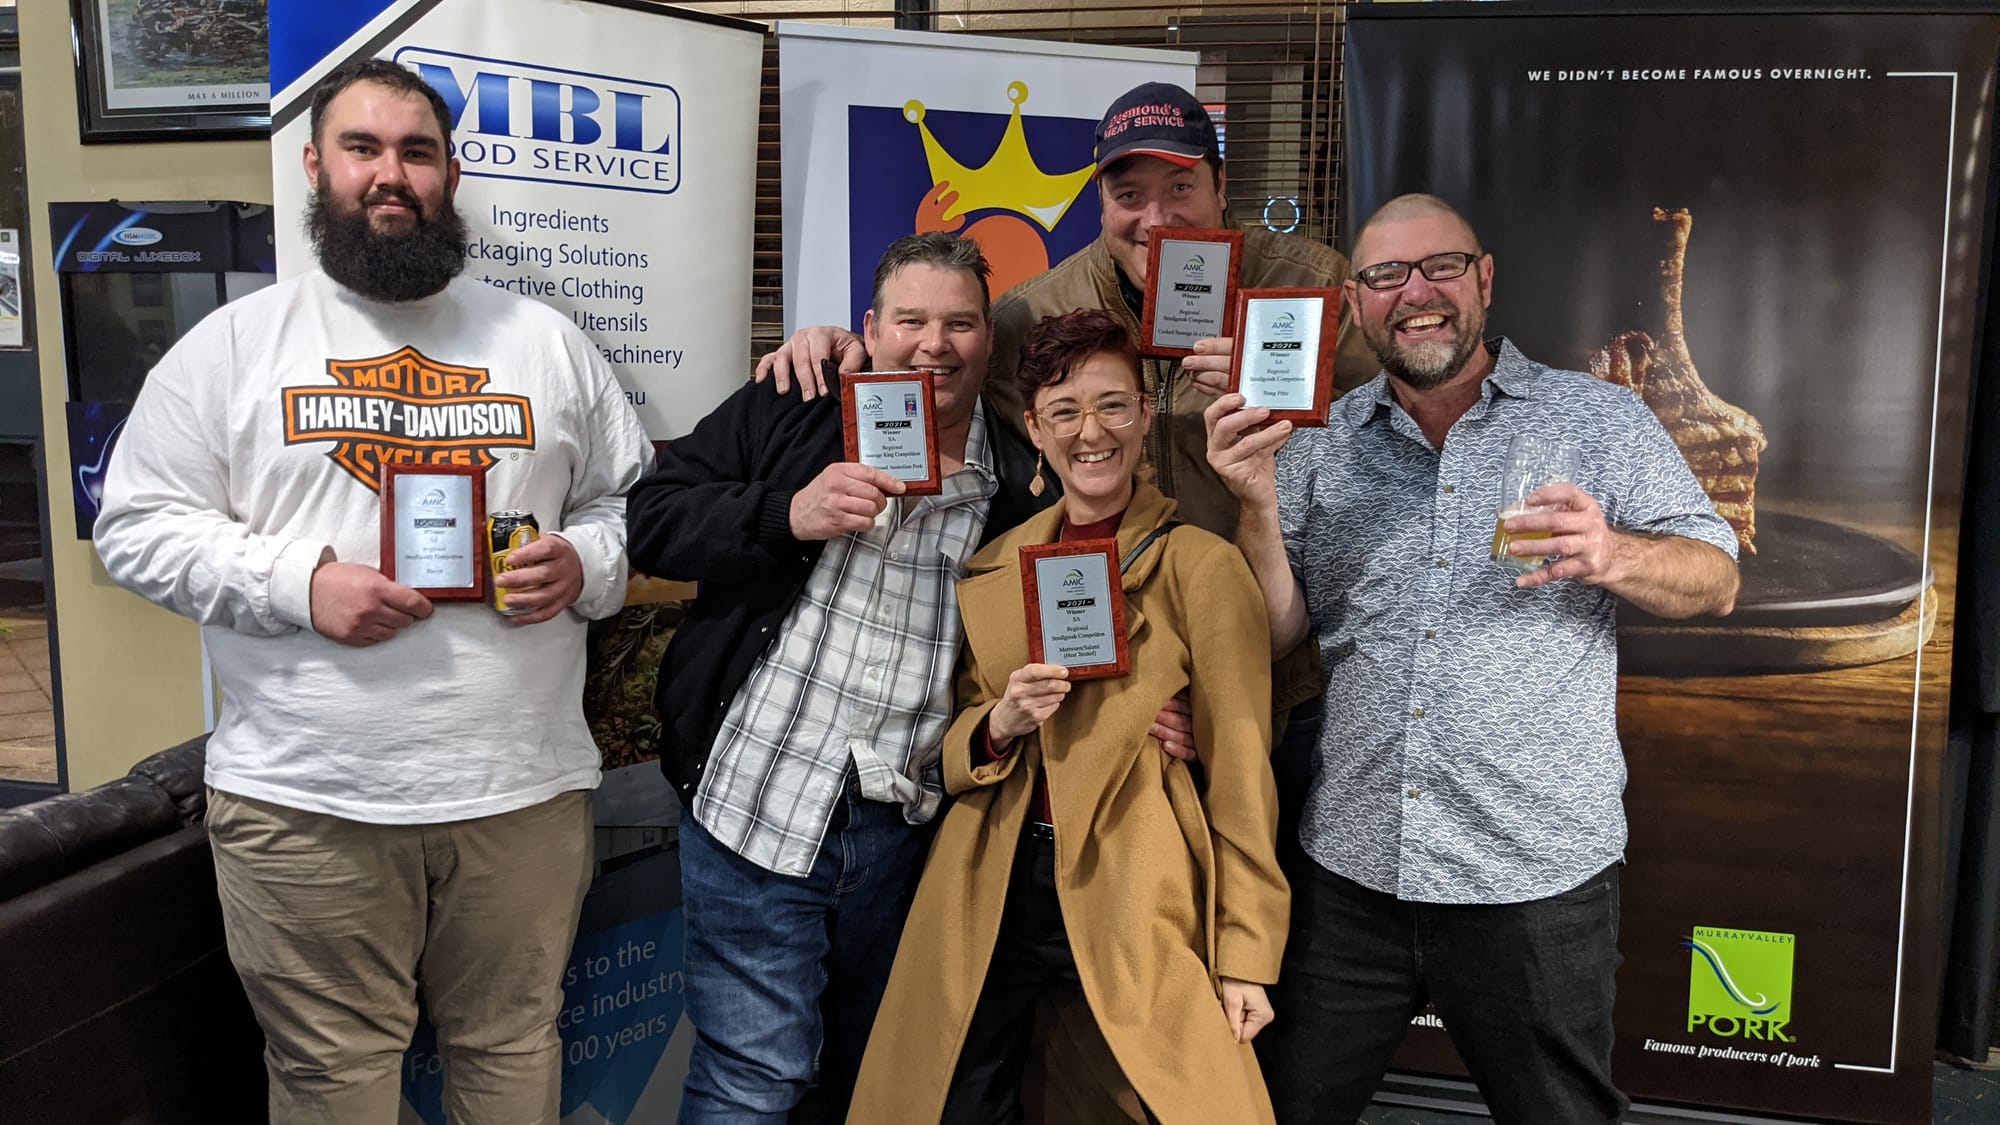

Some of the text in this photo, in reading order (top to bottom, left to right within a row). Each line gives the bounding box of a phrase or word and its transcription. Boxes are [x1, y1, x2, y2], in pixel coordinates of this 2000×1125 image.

[1528, 69, 1872, 81] WE DIDN'T BECOME FAMOUS OVERNIGHT.
[188, 90, 260, 100] MAX A MILLION
[407, 61, 670, 155] MBL
[1103, 115, 1185, 140] MEAT SERVICE
[450, 140, 670, 182] OD SERVICE
[493, 204, 609, 233] Ingredients
[76, 251, 201, 262] DIGITAL JUKEBOX
[559, 243, 649, 269] Solutions
[1183, 263, 1204, 271] AMIC
[561, 277, 644, 305] Clothing
[574, 310, 648, 333] Utensils
[596, 344, 684, 369] achinery
[353, 358, 468, 396] MOTOR
[299, 396, 522, 438] HARLEY-DAVIDSON
[863, 403, 883, 411] AMIC
[1063, 577, 1084, 587] AMIC
[1066, 599, 1086, 607] 2021
[1066, 625, 1088, 633] Regional
[1078, 631, 1105, 640] Competition
[1696, 929, 1793, 944] MURRAYVALLEY
[584, 957, 610, 980] to
[617, 940, 656, 969] the
[592, 970, 684, 1017] industry
[605, 1013, 667, 1059] years
[1687, 1014, 1790, 1043] PORK
[1643, 1038, 1821, 1068] Famous producers of pork
